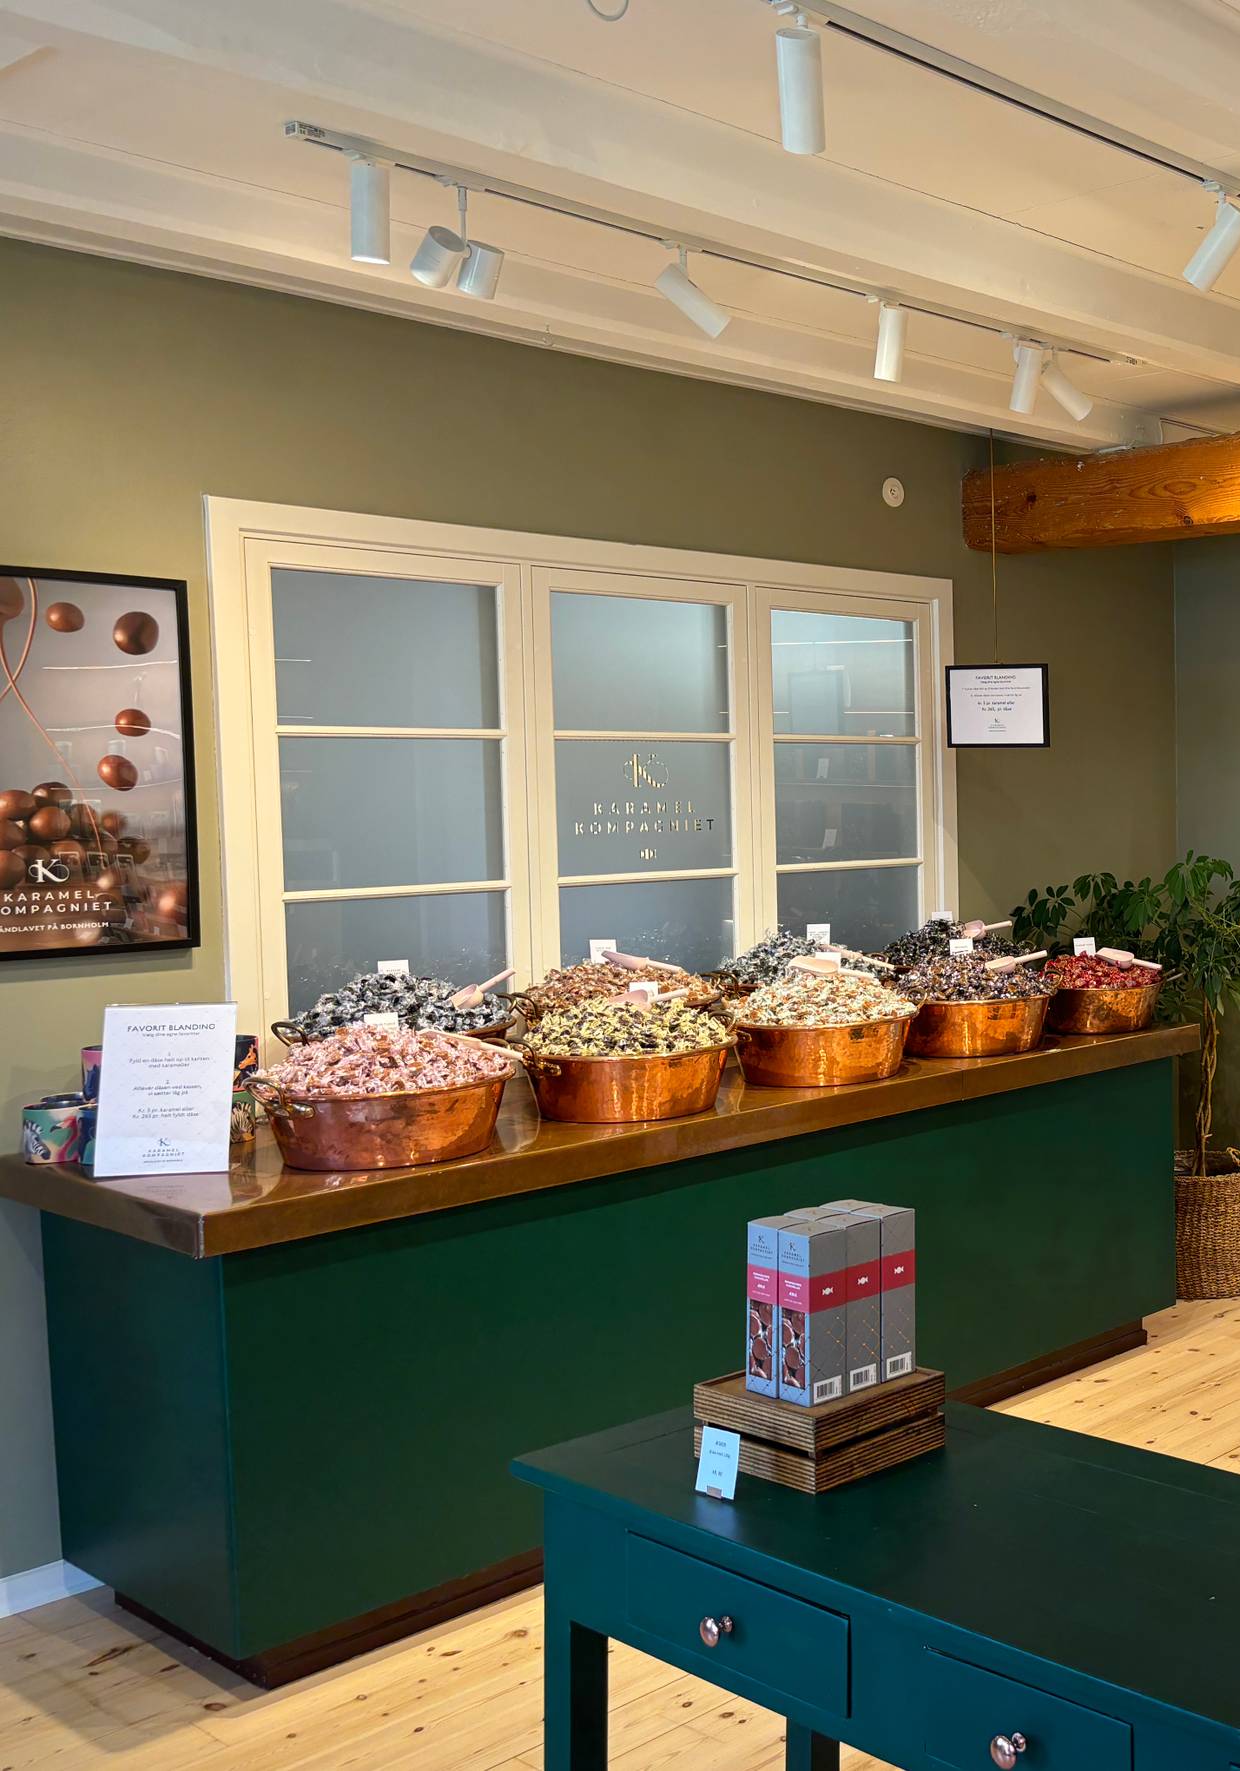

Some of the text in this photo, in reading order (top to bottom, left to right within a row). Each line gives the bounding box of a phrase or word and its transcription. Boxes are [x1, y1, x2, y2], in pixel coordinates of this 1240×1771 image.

[593, 800, 696, 816] KARAMEL
[574, 818, 714, 836] KOMPAGNIET
[3, 890, 95, 902] KARAMEL
[0, 901, 112, 915] OMPAGNIET
[47, 922, 59, 930] PÅ
[60, 921, 109, 930] BORNHOLM
[168, 1023, 216, 1031] BLANDING
